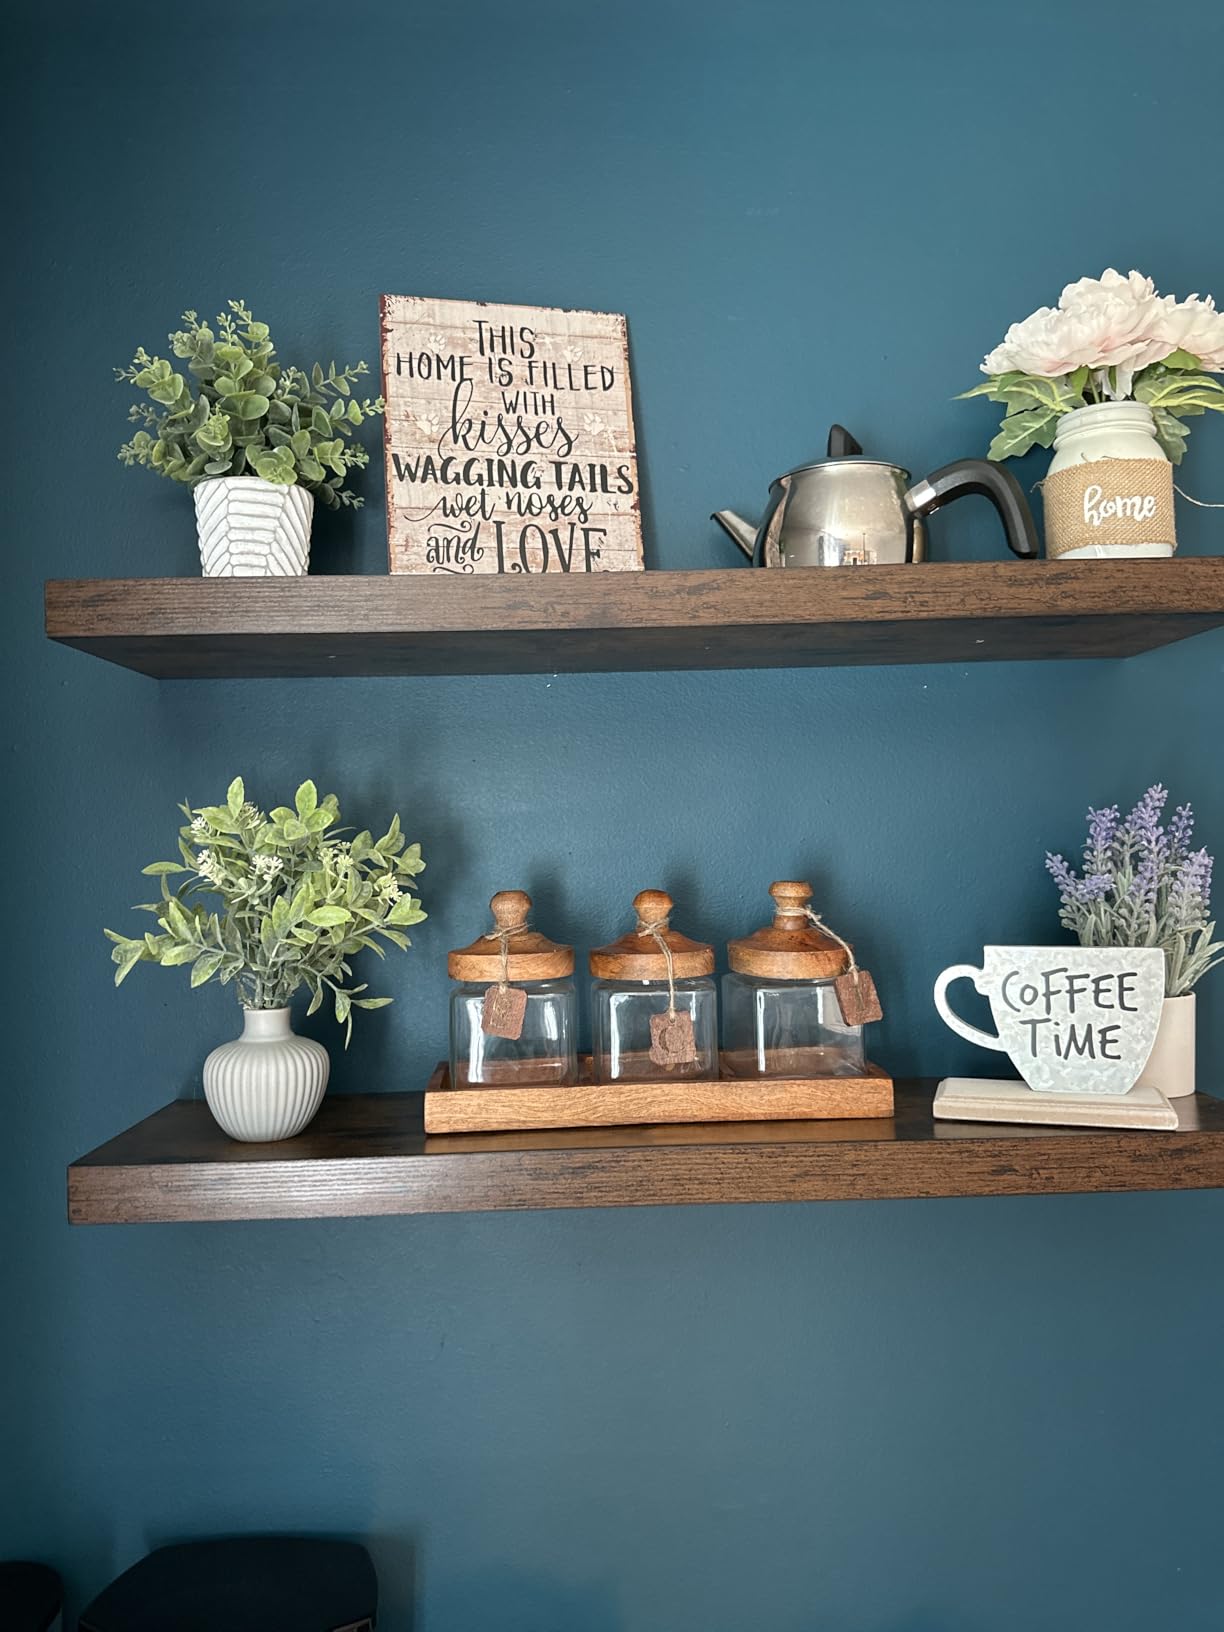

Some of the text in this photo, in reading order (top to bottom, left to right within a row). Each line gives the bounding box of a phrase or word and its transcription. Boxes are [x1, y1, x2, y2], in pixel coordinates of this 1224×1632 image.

[472, 319, 537, 358] THIS
[396, 351, 615, 392] HOME IS FILLED
[438, 378, 579, 460] kisses
[501, 390, 556, 416] WITH
[391, 453, 634, 494] WAGGING TAILS
[404, 488, 593, 524] wet noses
[1083, 485, 1156, 526] home
[426, 520, 608, 573] and LOVE
